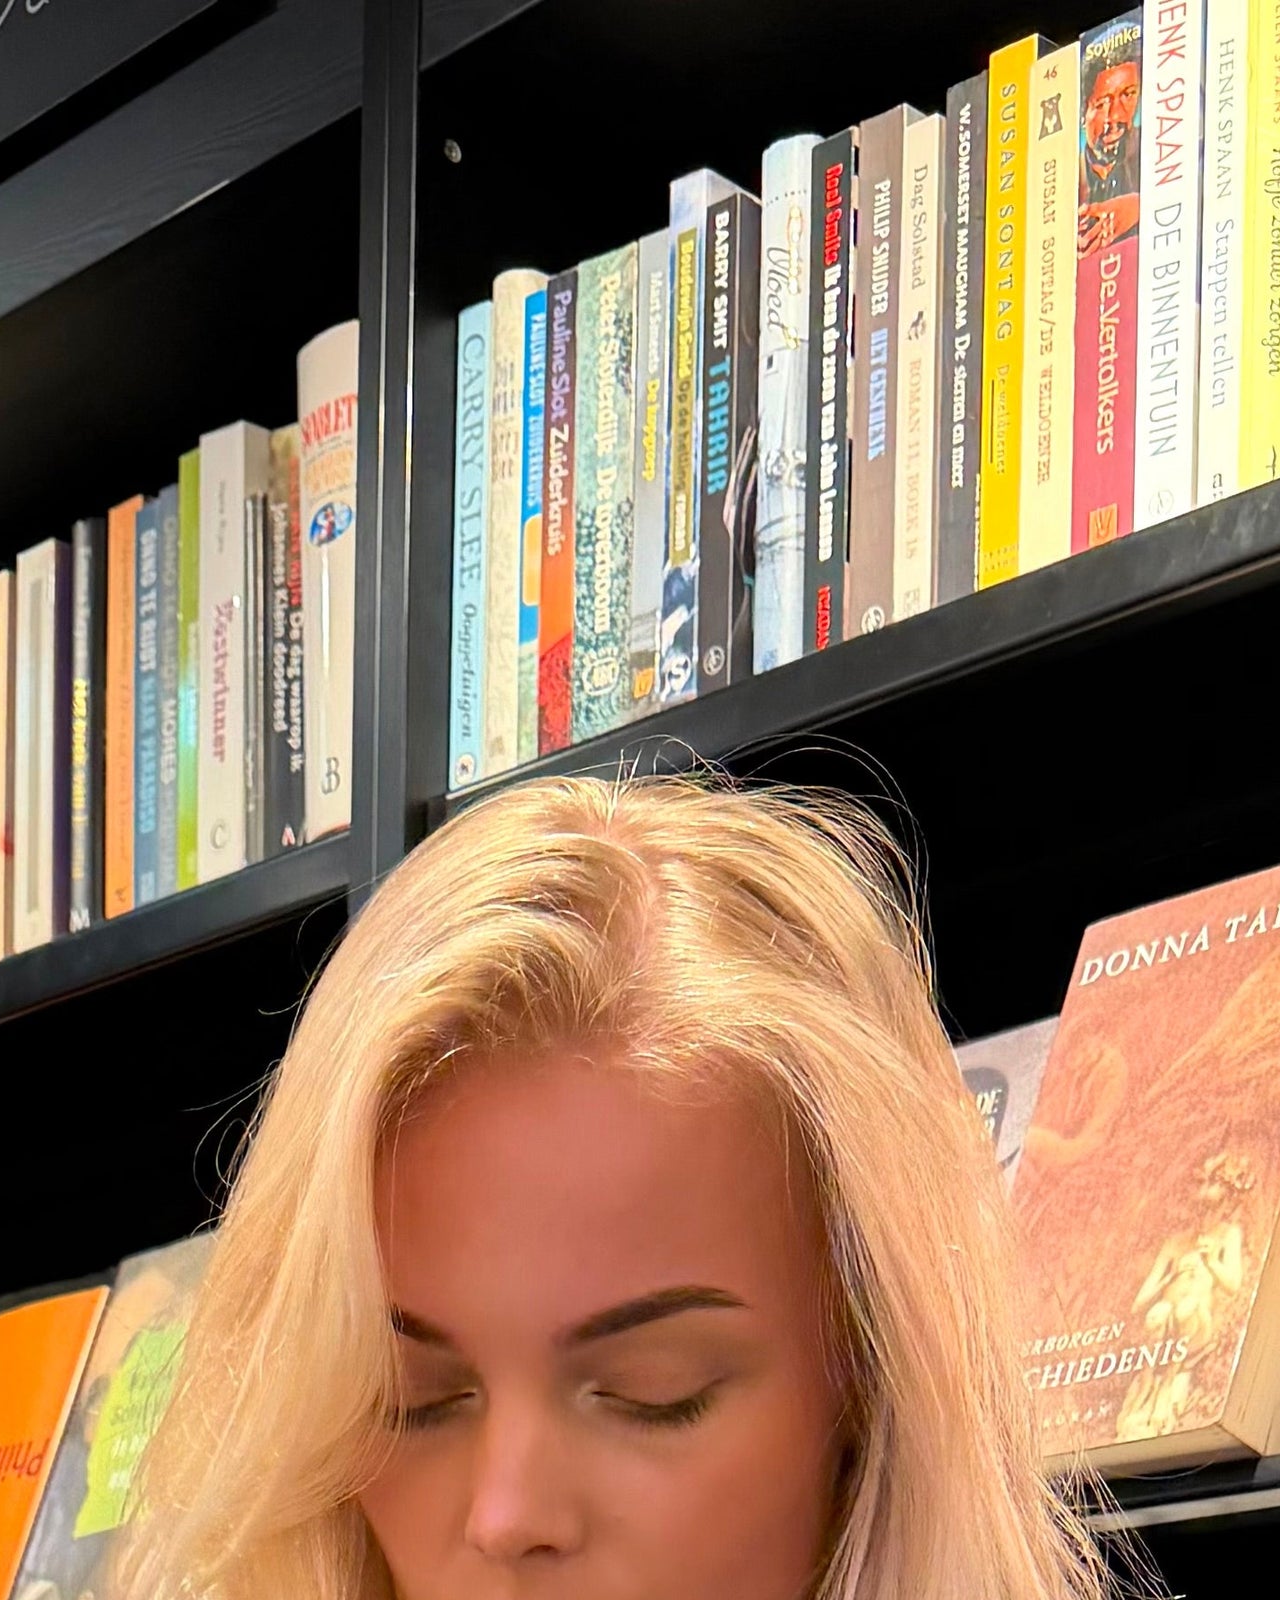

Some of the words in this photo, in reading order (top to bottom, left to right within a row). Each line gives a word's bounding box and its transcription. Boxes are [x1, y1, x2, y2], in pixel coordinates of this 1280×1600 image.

[1153, 77, 1185, 188] SPAAN
[712, 211, 730, 289] BARRY
[1152, 203, 1182, 250] DE
[550, 291, 571, 377] Pauline
[712, 294, 730, 348] SMIT
[1148, 262, 1179, 458] BINNENTUIN
[460, 334, 487, 479] CARRY
[550, 379, 568, 420] Slot
[706, 356, 731, 496] TAHRIR
[1095, 308, 1120, 455] Vertolkers
[546, 424, 569, 555] Zuiderkruis
[596, 468, 617, 500] De
[458, 488, 484, 589] SLEE
[456, 603, 478, 740] Ooggetuigen
[1077, 924, 1210, 988] DONNA
